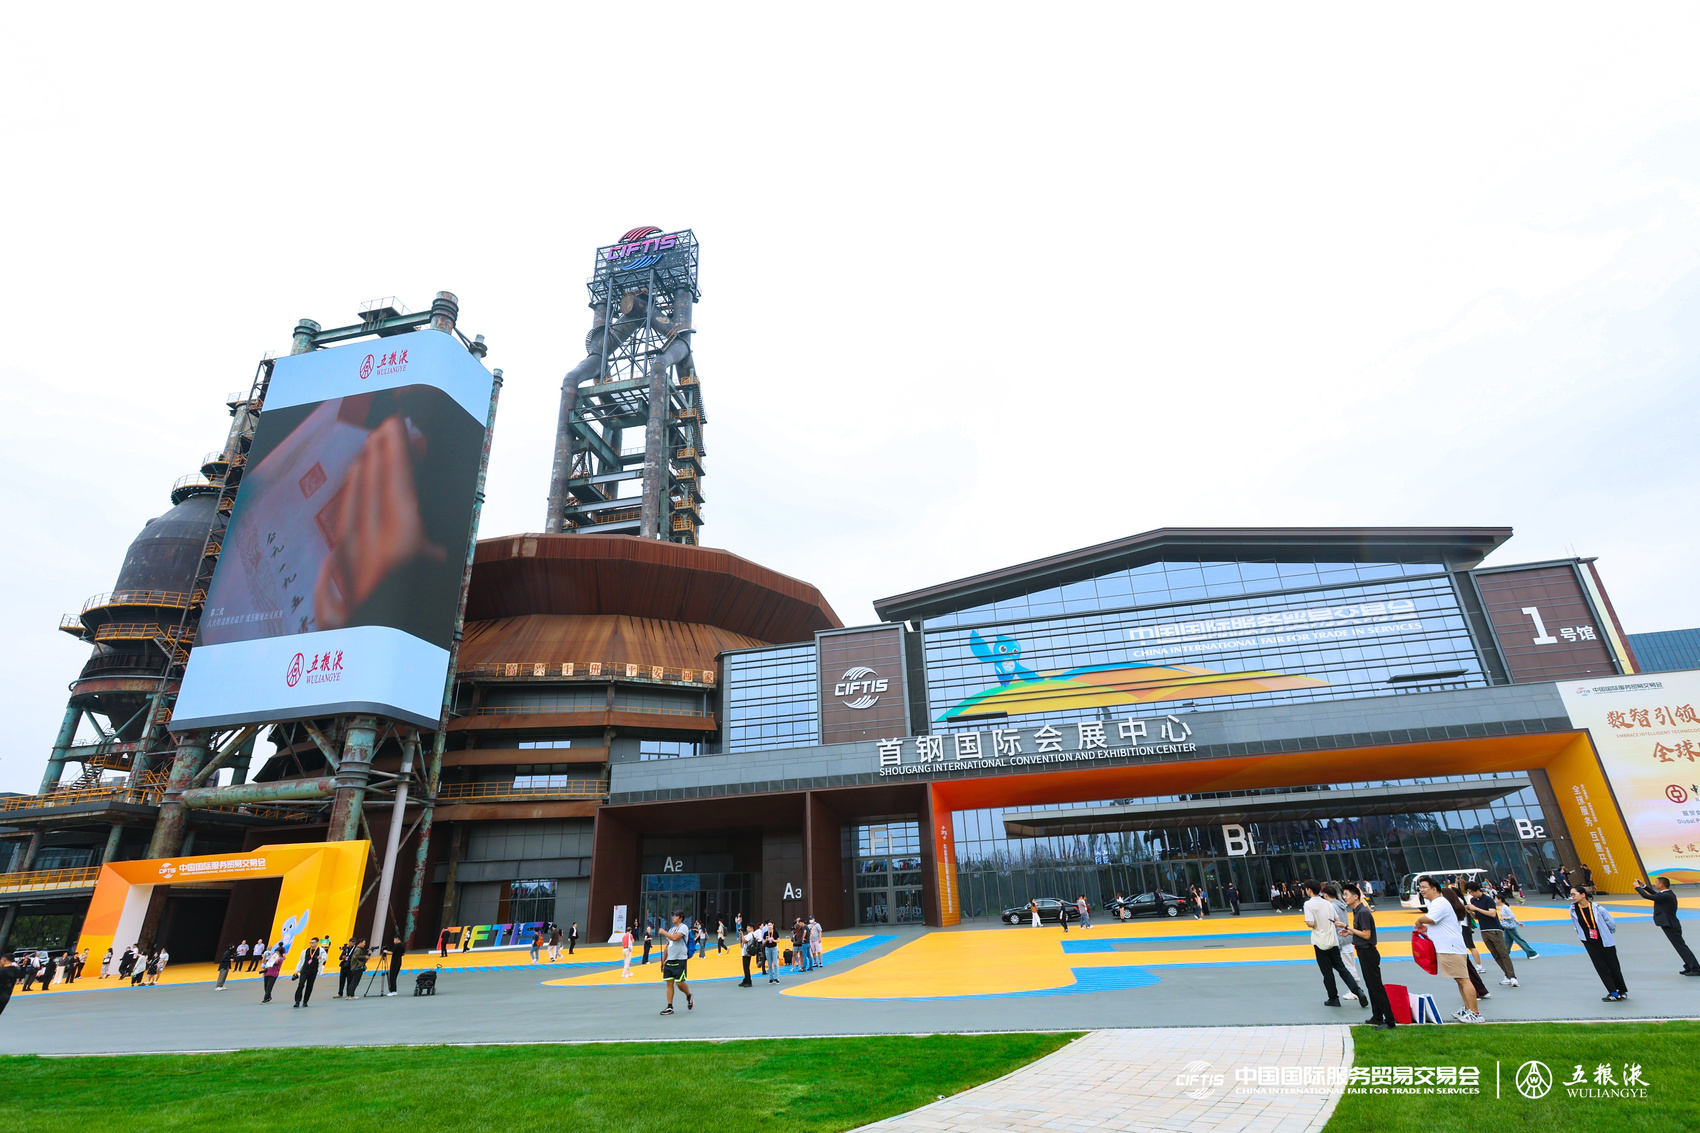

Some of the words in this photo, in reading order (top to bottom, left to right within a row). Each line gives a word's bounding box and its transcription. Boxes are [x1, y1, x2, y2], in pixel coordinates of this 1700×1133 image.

[607, 235, 677, 260] CIFTIS
[377, 349, 408, 368] 五粮液
[377, 365, 407, 376] WULIANGYE
[1129, 599, 1418, 646] 中国国际服务贸易交易会
[1133, 648, 1168, 657] CHINA
[1167, 640, 1259, 654] INTERNATIONAL
[1261, 635, 1284, 644] FAIR
[1287, 633, 1310, 642] FOR
[1312, 629, 1349, 639] TRADE
[1352, 627, 1365, 636] IN
[1367, 622, 1423, 633] SERVICES
[307, 650, 344, 674] 五粮液
[306, 672, 341, 684] WULIANGYE
[834, 679, 889, 696] CIFTIS
[1607, 704, 1700, 729] 数智引领
[876, 715, 1193, 766] 首钢国际会展中心
[1653, 739, 1700, 763] 全球
[879, 765, 931, 777] SHOUGANG
[933, 758, 1006, 772] INTERNATIONAL
[1010, 753, 1073, 766] CONVENTION
[1075, 750, 1095, 761] AND
[1098, 745, 1155, 759] EXHIBITION
[1156, 742, 1197, 754] CENTER
[1572, 785, 1593, 827] 全球服务
[1514, 818, 1547, 839] B2
[179, 858, 266, 872] 中国国际服务贸易交易会
[663, 856, 683, 872] A2
[783, 882, 802, 899] A3
[436, 922, 544, 950] CIFTIS
